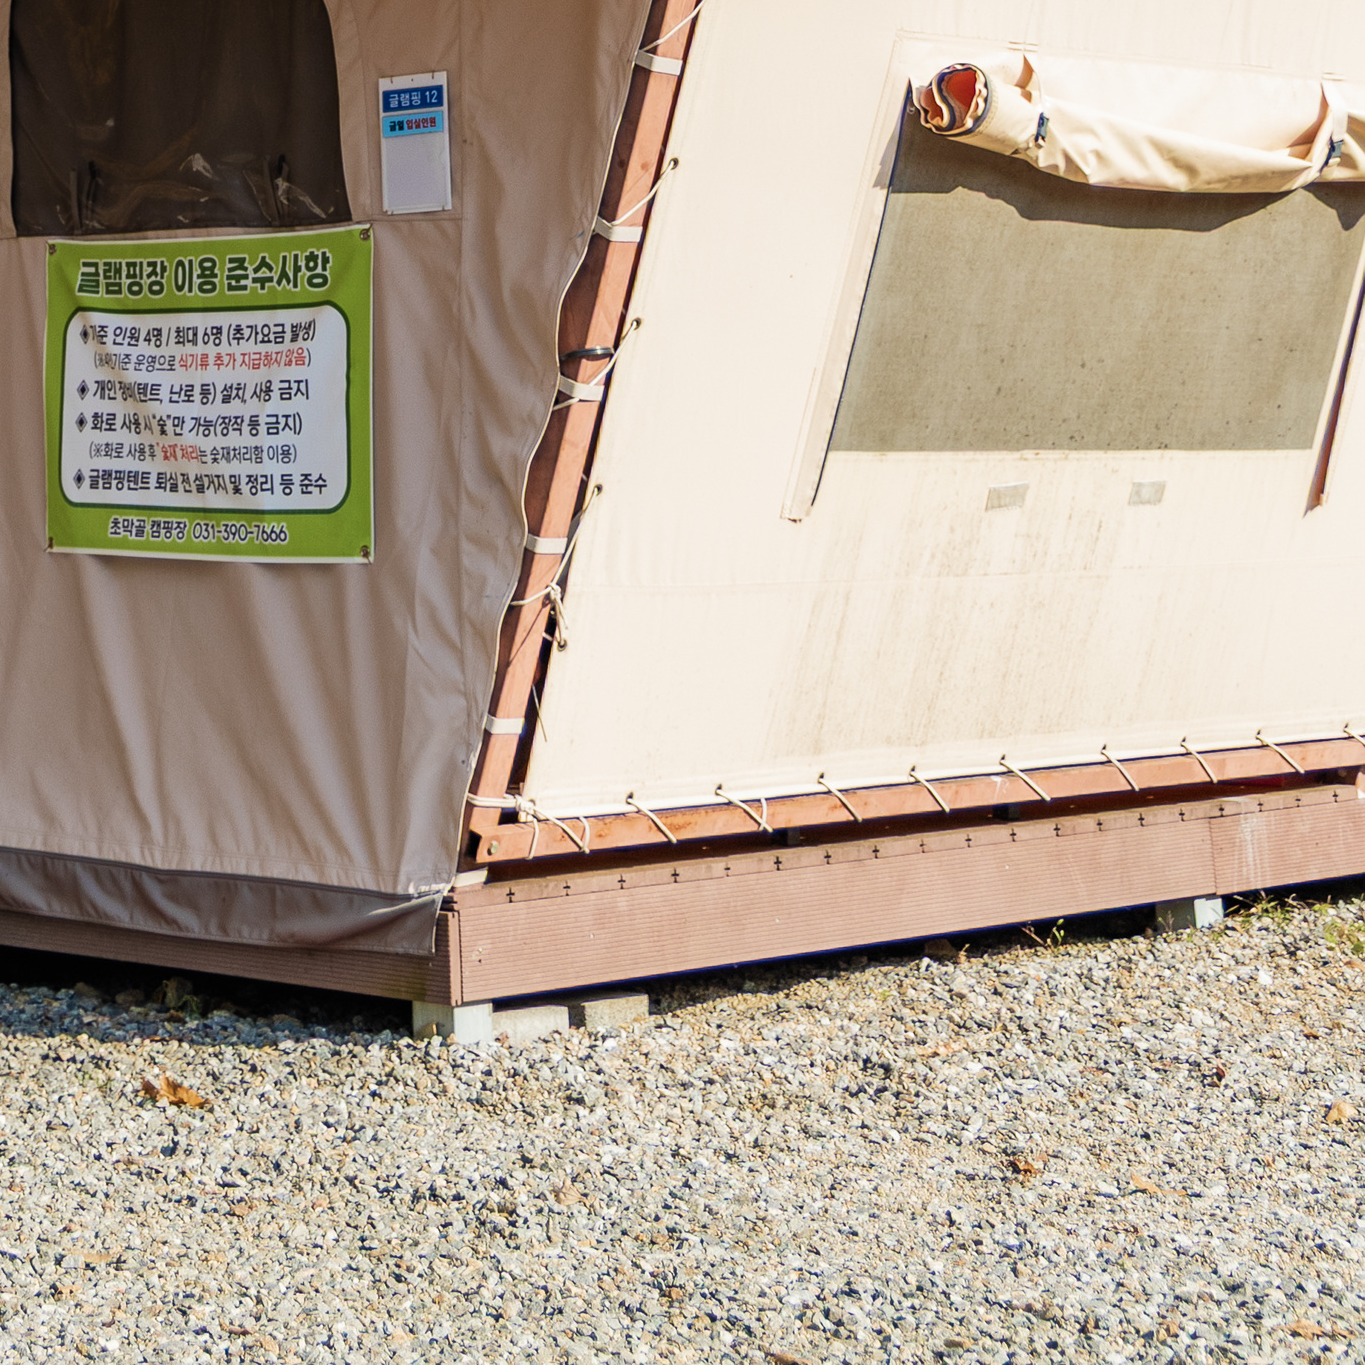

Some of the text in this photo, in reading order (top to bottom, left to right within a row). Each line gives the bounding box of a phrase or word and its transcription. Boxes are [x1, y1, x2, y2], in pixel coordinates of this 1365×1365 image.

[388, 90, 438, 108] 글램핑 12
[77, 250, 331, 298] 글램핑장 이용 준수사항
[90, 325, 109, 345] 기준
[113, 326, 141, 347] 인원
[144, 327, 163, 348] 4명
[175, 326, 198, 347] 최대
[202, 325, 223, 348] 6명
[227, 323, 286, 347] (추가요금
[290, 318, 316, 343] 발생)
[134, 354, 176, 372] 운영으로
[179, 353, 210, 371] 식기류
[213, 352, 236, 371] 추가
[240, 350, 284, 370] 지급하지
[284, 347, 311, 367] 않음)
[93, 380, 117, 401] 개인
[169, 384, 195, 403] 난로
[199, 382, 216, 405] 등)
[220, 383, 247, 405] 설치,
[250, 380, 274, 402] 사용
[278, 379, 309, 401] 금지
[91, 412, 117, 433] 화로
[120, 413, 142, 435] 사용
[247, 415, 260, 437] 등
[265, 411, 302, 436] 금지)
[126, 442, 146, 461] 사용
[210, 446, 264, 464] 숯재처리함
[267, 443, 297, 464] 이용)
[88, 468, 328, 496] 글램핑텐트 퇴실 전 설거지 및 정리 등 준수
[109, 517, 289, 543] 초막골 캠핑장 031-390-7666
